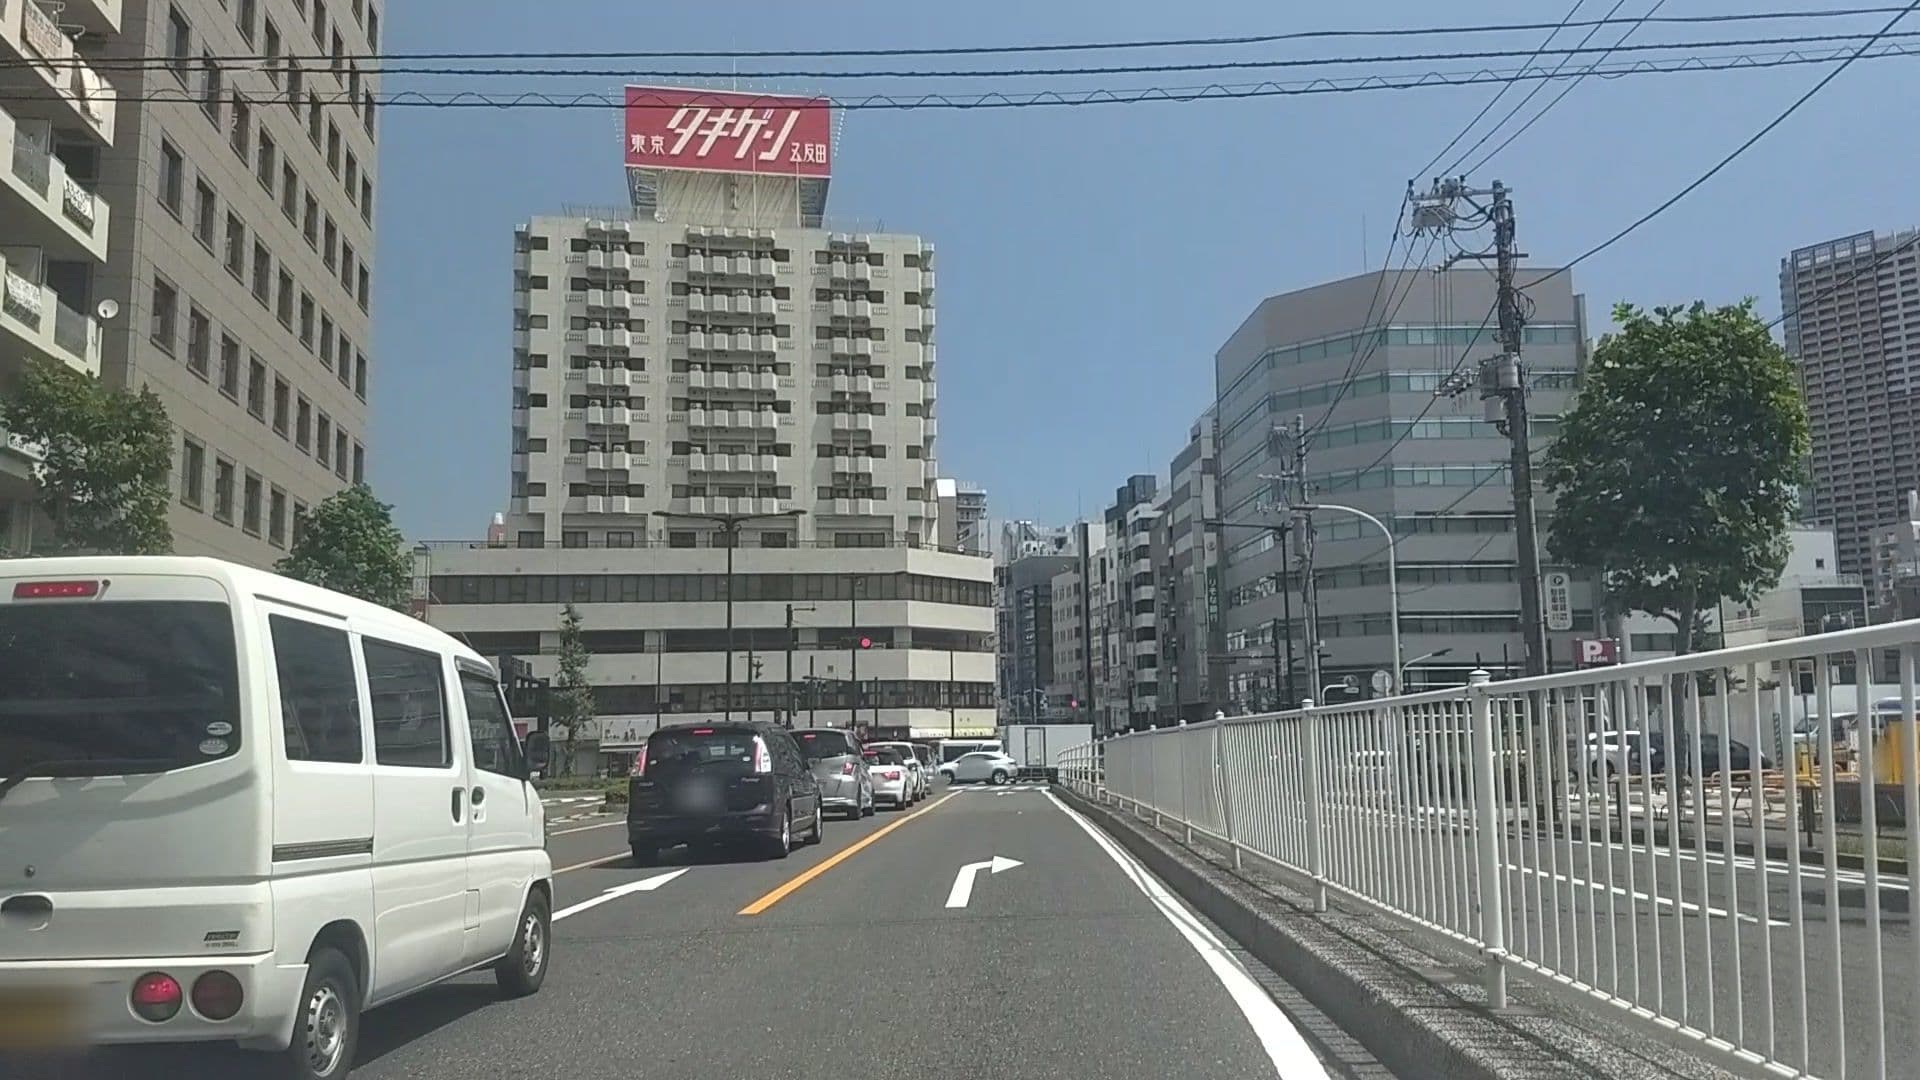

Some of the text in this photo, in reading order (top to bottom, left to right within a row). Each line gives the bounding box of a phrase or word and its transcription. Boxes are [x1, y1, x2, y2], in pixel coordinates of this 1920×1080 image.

[630, 104, 827, 163] 東京 タキゲン 五反田
[1583, 640, 1603, 662] P
